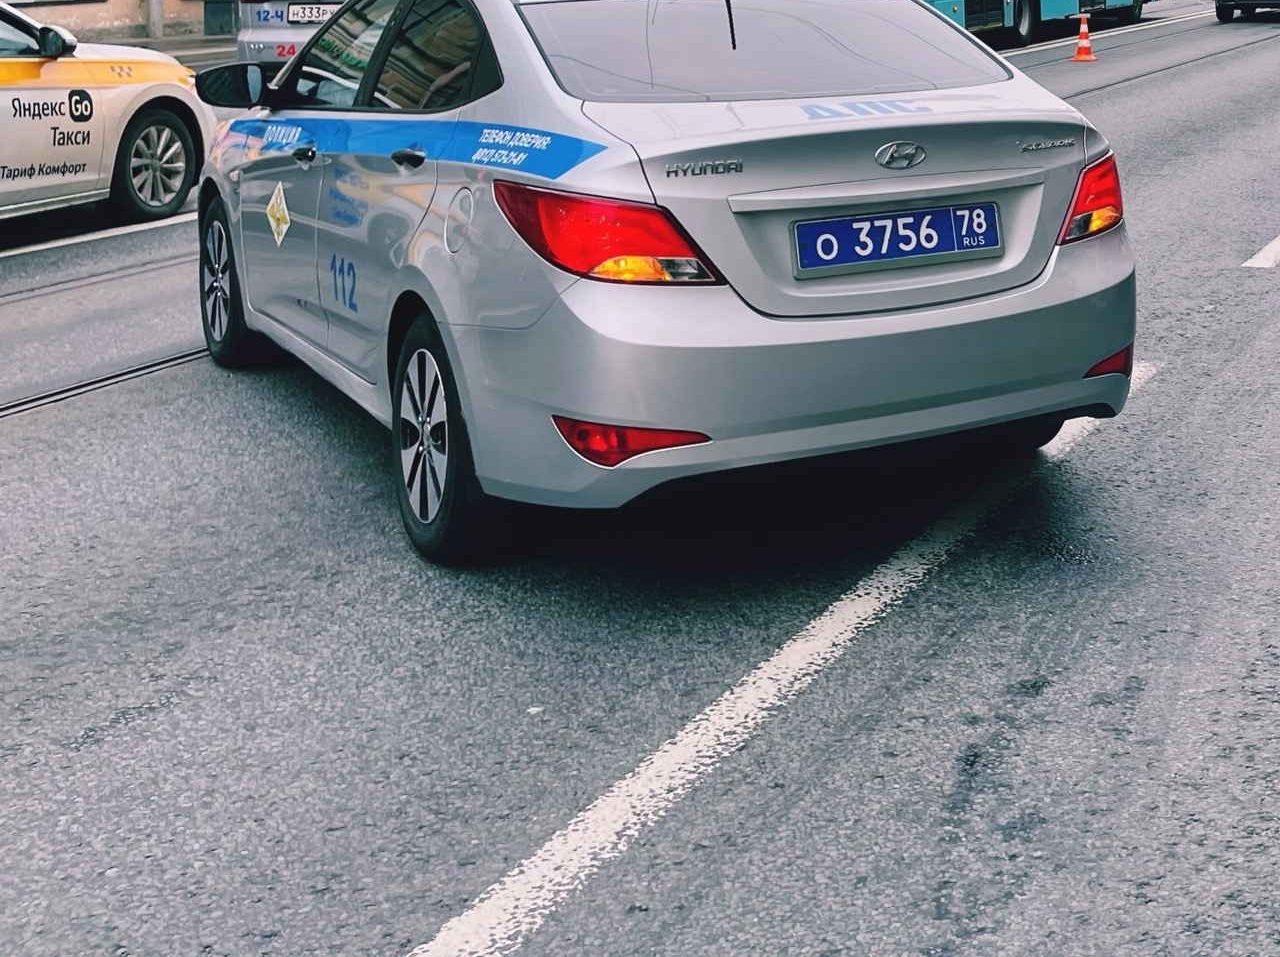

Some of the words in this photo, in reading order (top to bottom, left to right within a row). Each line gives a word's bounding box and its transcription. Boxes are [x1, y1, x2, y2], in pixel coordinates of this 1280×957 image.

[276, 44, 297, 57] 24
[12, 98, 66, 120] Яндекс
[71, 95, 91, 117] Go
[51, 126, 91, 147] Такси
[1, 165, 35, 181] Тариф
[38, 162, 87, 177] Комфорт
[665, 159, 744, 178] HYUNDAI
[852, 215, 939, 257] 3756
[956, 208, 987, 236] 78
[963, 236, 986, 247] RUS
[330, 254, 358, 313] 112
